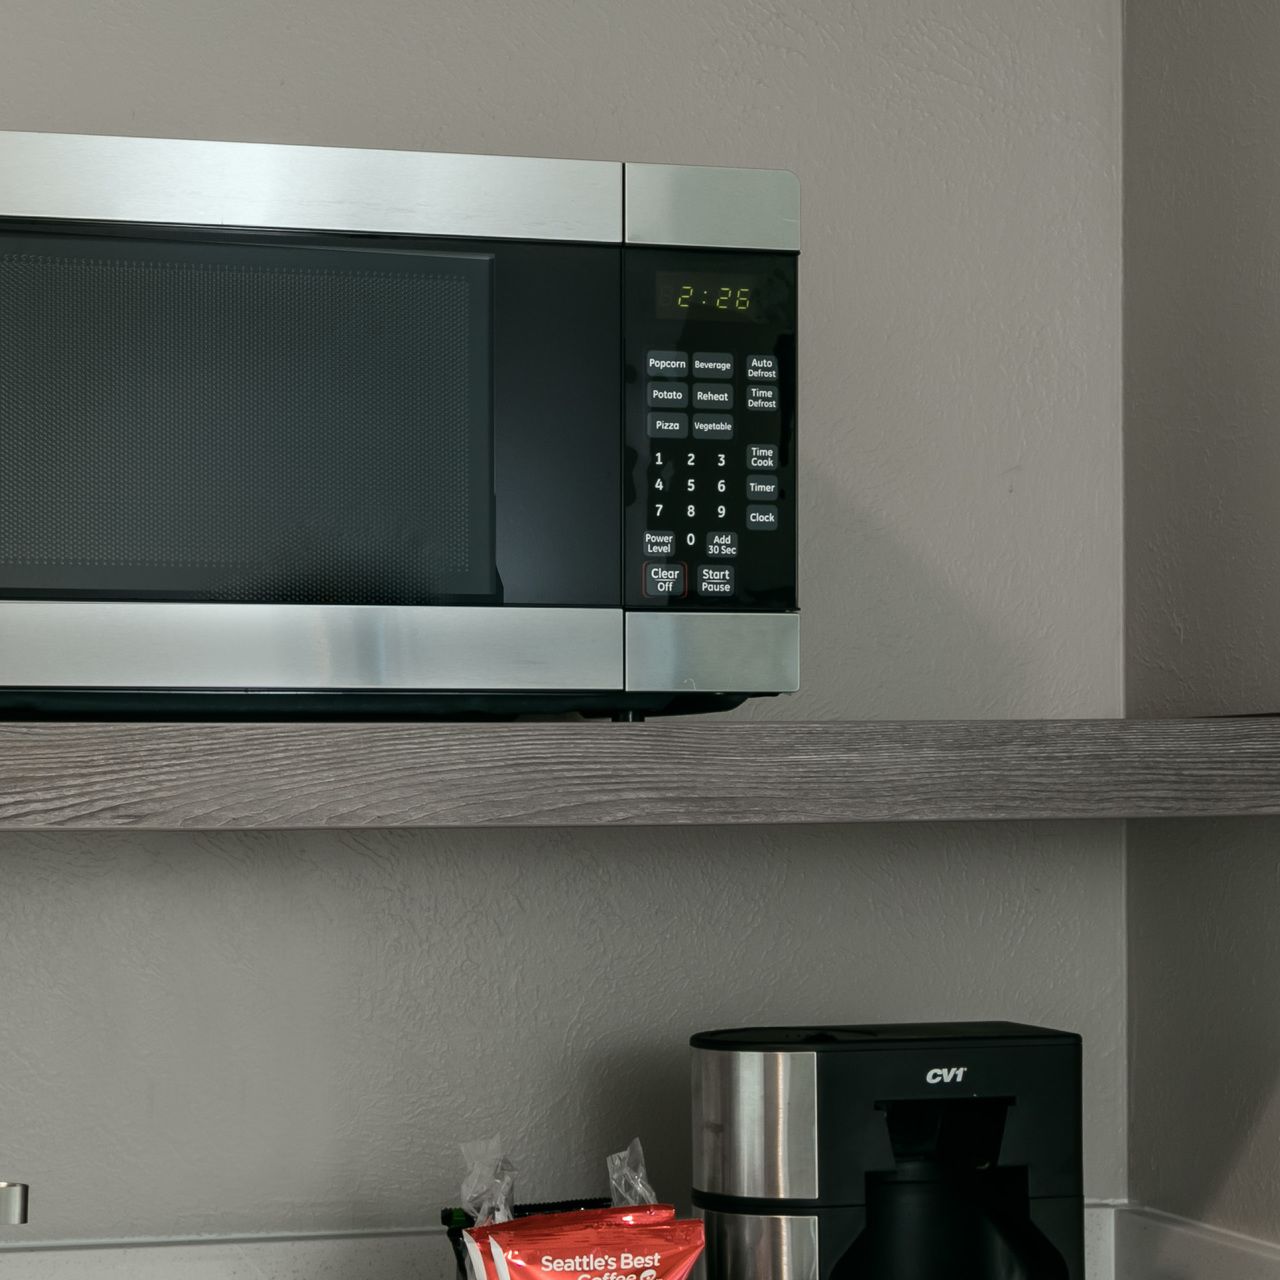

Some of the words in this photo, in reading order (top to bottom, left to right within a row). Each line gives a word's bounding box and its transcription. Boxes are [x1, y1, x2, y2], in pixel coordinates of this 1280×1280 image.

[677, 286, 750, 310] 2:26
[649, 359, 686, 370] Popcorn
[694, 360, 732, 371] Beverage
[751, 358, 773, 368] Auto
[747, 369, 776, 378] Defrost
[652, 389, 683, 400] Potato
[697, 391, 729, 402] Reheat
[751, 388, 773, 398] Time
[747, 399, 776, 408] Defrost
[656, 421, 680, 431] Pizza
[694, 422, 732, 432] Vegetable
[751, 447, 773, 457] Time
[655, 452, 663, 465] 1
[687, 453, 695, 466] 2
[717, 454, 726, 467] 3
[751, 457, 773, 467] Cook
[654, 478, 664, 491] 4
[687, 479, 695, 491] 5
[717, 480, 726, 492] 6
[750, 483, 775, 492] Timer
[655, 504, 664, 517] 7
[687, 505, 695, 517] 8
[717, 505, 726, 518] 9
[750, 512, 775, 522] Clock
[645, 534, 673, 543] Power
[686, 533, 695, 546] 0
[713, 535, 731, 545] Add
[647, 544, 671, 553] Level
[708, 545, 719, 554] 30
[721, 545, 737, 555] Sec
[651, 568, 679, 579] Clear
[702, 569, 730, 580] Start
[657, 582, 673, 592] Off
[702, 582, 730, 592] Pause
[541, 1254, 617, 1271] Seattle's
[620, 1252, 661, 1269] Best
